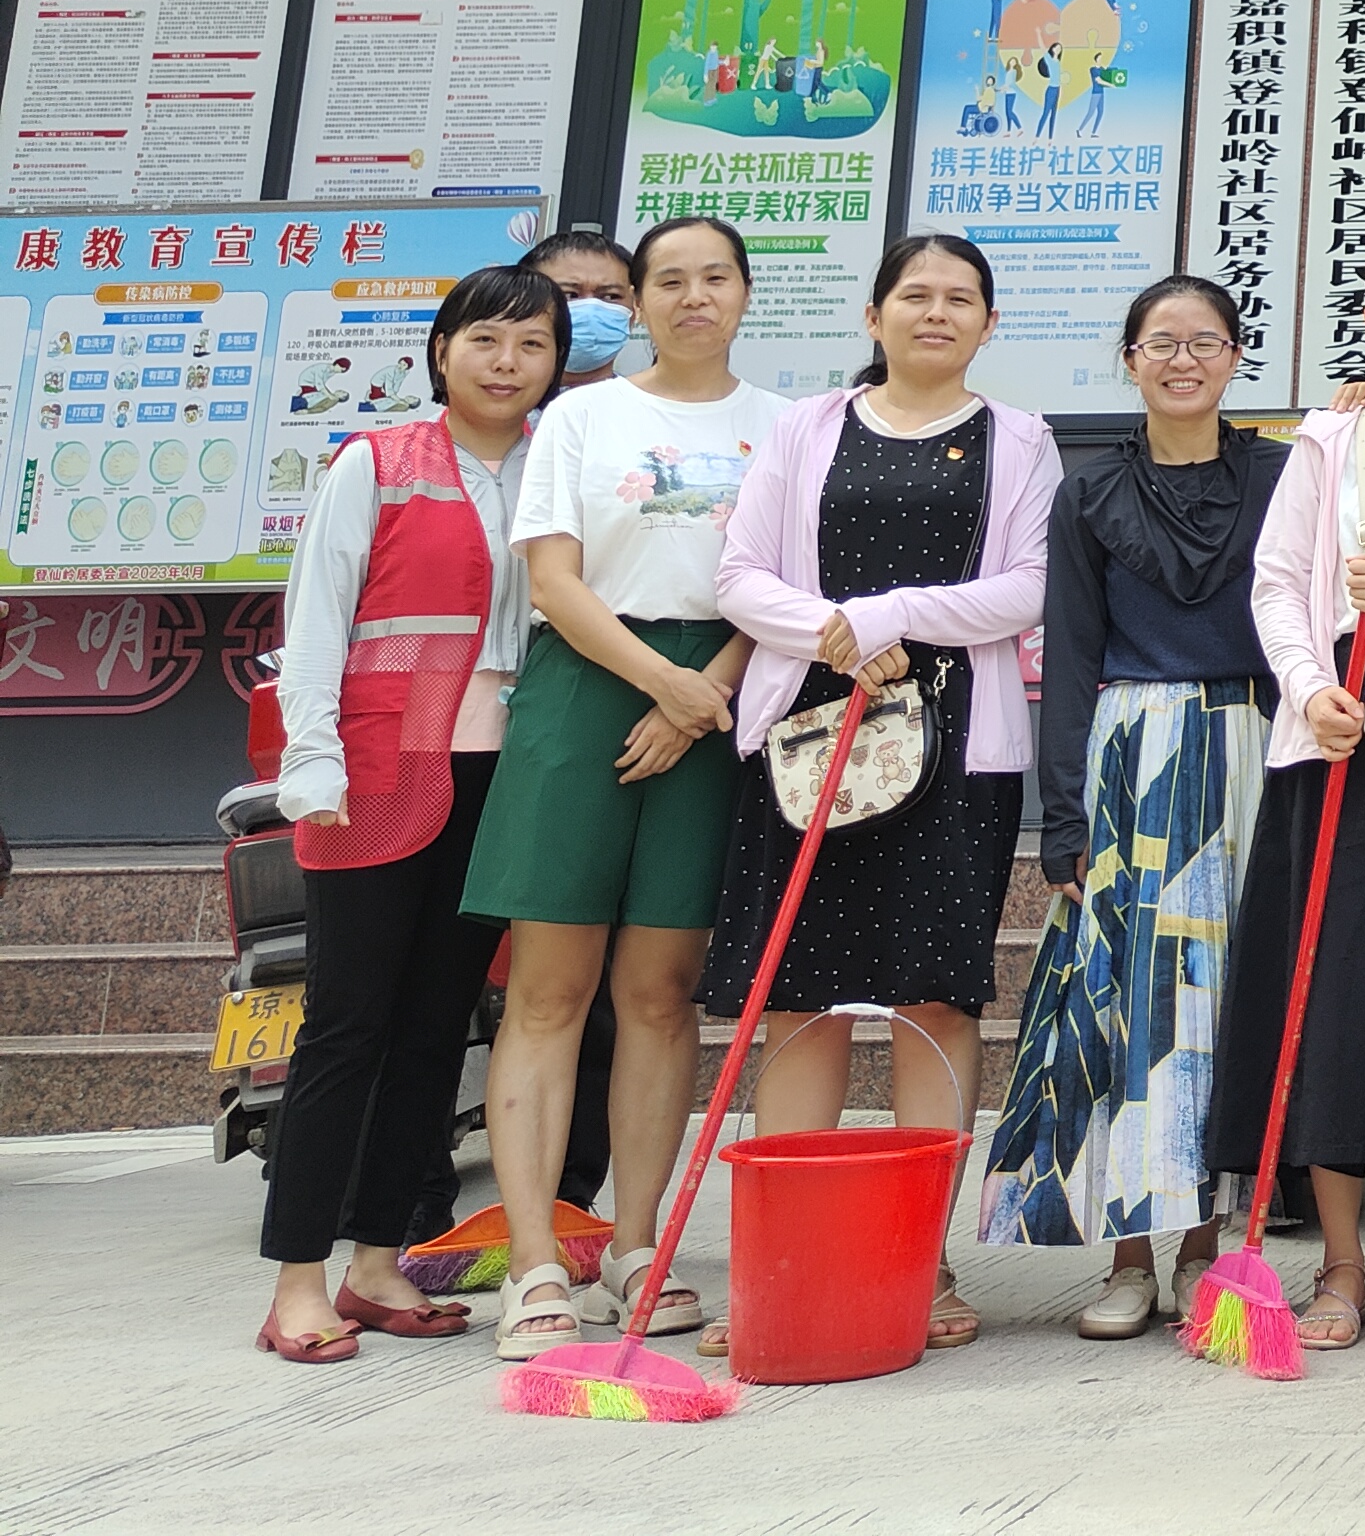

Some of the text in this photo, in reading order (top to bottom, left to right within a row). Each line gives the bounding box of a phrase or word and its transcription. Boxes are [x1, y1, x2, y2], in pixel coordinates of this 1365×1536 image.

[640, 151, 875, 186] 爱护公共环境卫生
[931, 144, 1163, 178] 携手维护社区文明
[635, 189, 871, 224] 共建共享美好家园
[926, 181, 1160, 214] 积极争当文明市民
[16, 221, 388, 272] 康教育宣传栏
[125, 285, 193, 302] 传染病防控
[356, 281, 437, 297] 应急救护知识
[372, 311, 410, 322] 心肺复苏
[35, 566, 205, 583] 登仙岭居委会宣2023年4月
[0, 595, 147, 691] 文明
